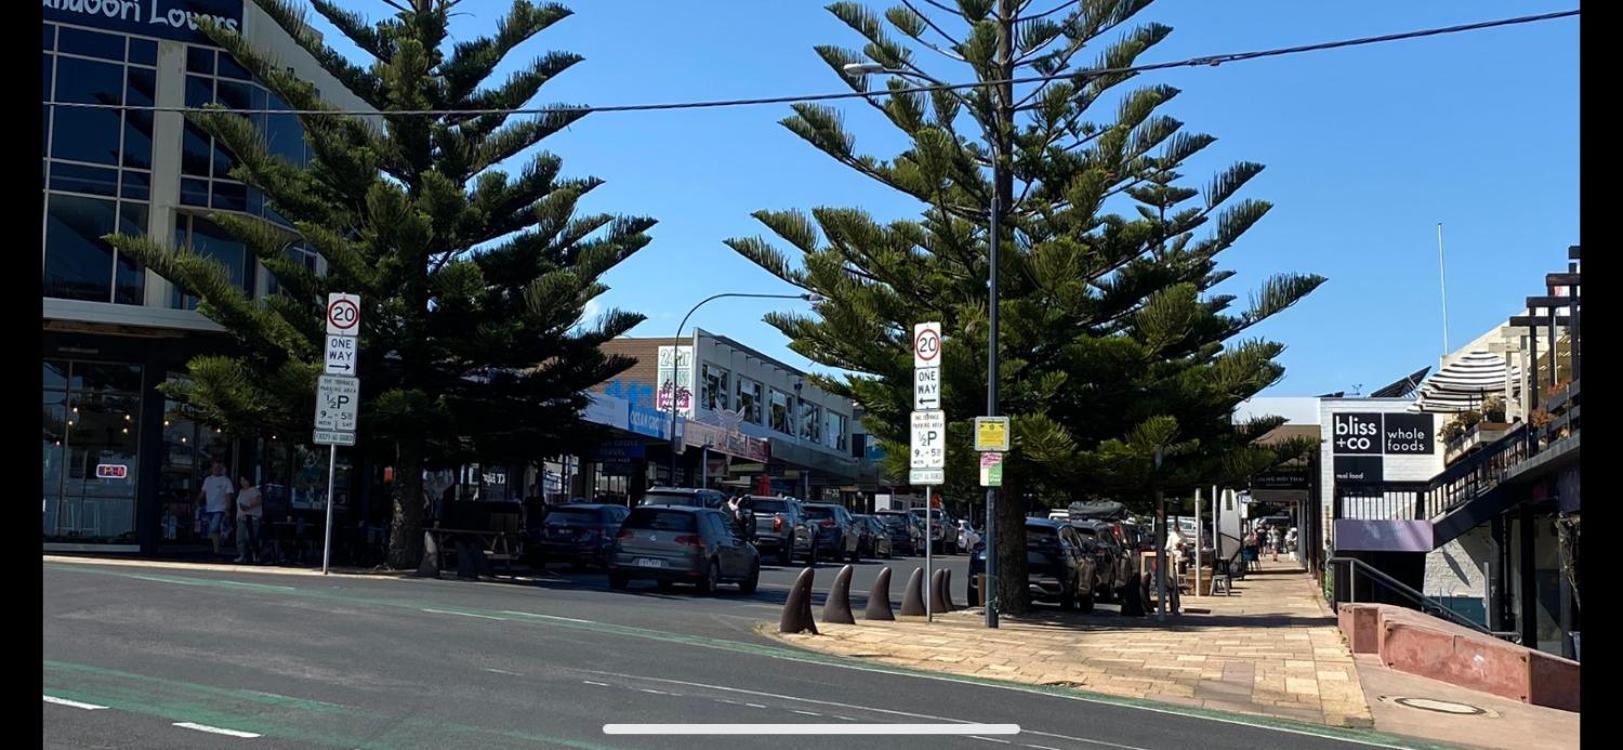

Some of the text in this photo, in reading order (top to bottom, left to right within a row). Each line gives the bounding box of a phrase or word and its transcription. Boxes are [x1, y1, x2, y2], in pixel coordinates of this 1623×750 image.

[333, 306, 355, 322] 20
[331, 338, 352, 349] ONE
[919, 336, 937, 353] 20
[328, 350, 353, 361] WAY
[919, 371, 936, 381] ONE
[918, 384, 937, 394] WAY
[1335, 415, 1377, 435] bliss
[1387, 427, 1425, 440] whole
[1387, 439, 1425, 451] foods
